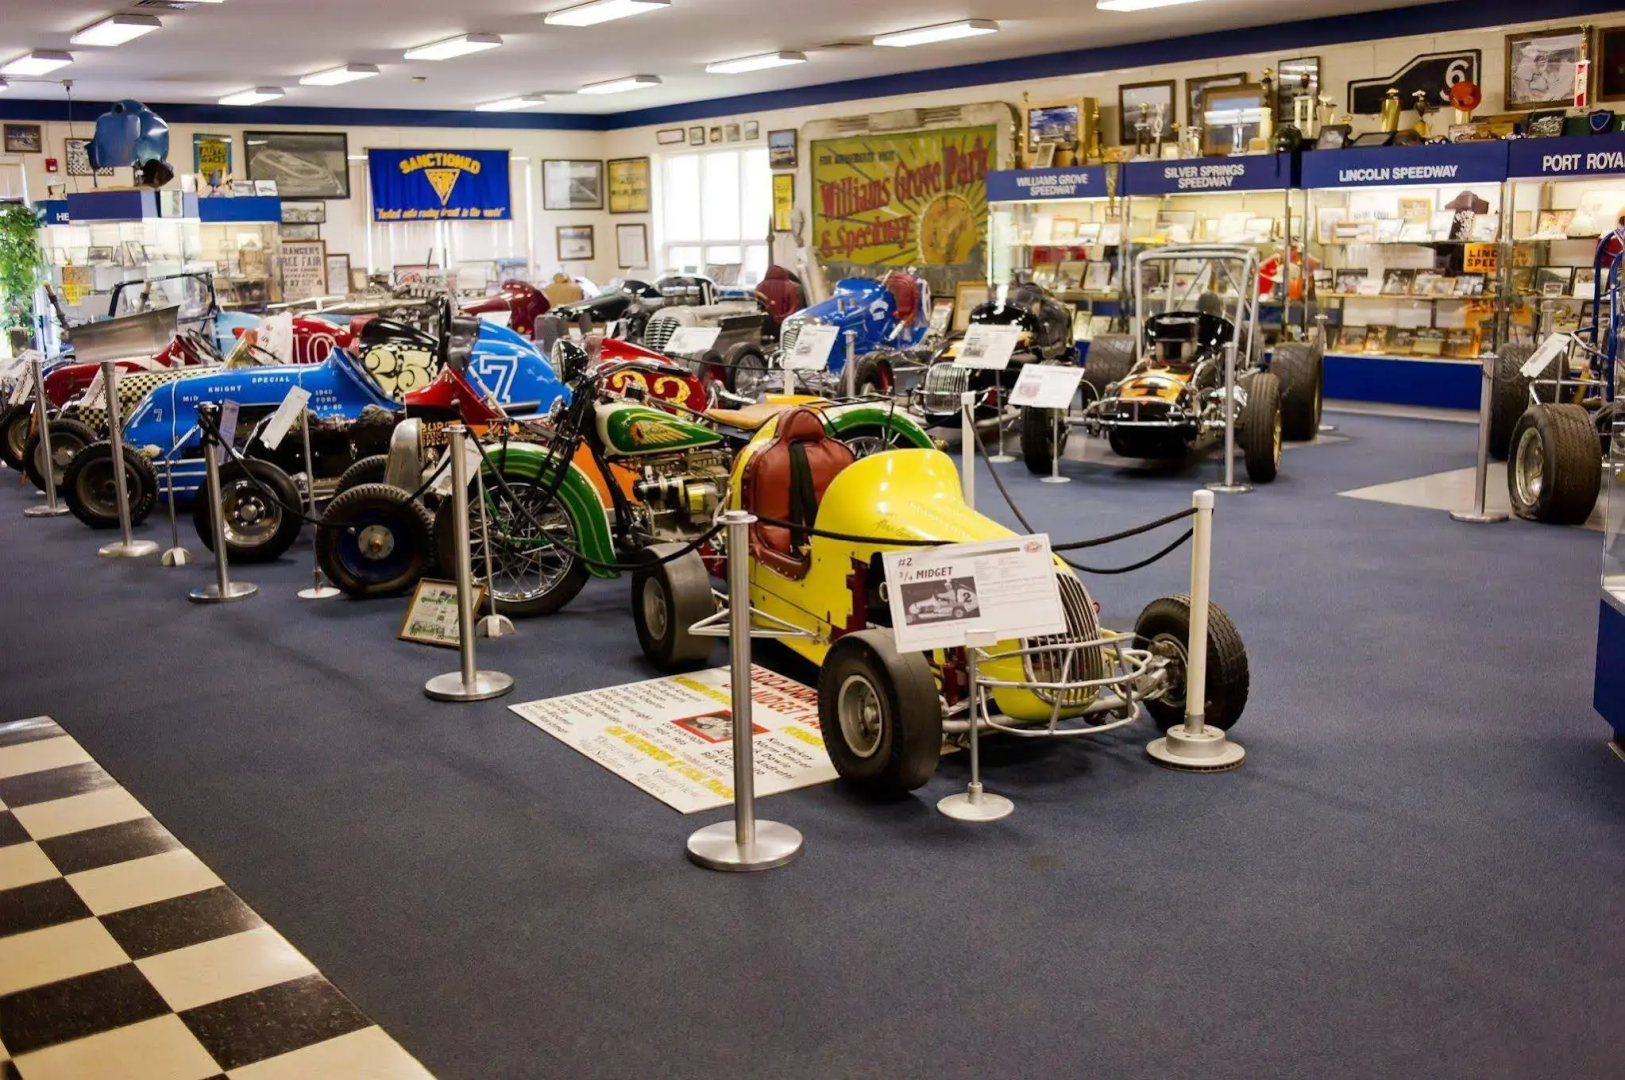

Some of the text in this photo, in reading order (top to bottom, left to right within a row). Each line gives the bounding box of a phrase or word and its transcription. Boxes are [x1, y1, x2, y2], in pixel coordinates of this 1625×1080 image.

[399, 152, 481, 175] SANCTIONED
[1542, 154, 1581, 171] PORT
[1164, 163, 1245, 178] SILVER SPRINGS
[1339, 165, 1458, 182] LINCOLN SPEEDWAY
[820, 177, 890, 222] Williams
[895, 160, 941, 202] Grove
[942, 137, 989, 190] Park
[1016, 173, 1088, 187] WILLIAMS GROVE
[1178, 175, 1233, 188] SPEEDWAY
[1030, 184, 1076, 196] SPEEDWAY
[837, 216, 911, 257] Speedway
[365, 350, 431, 393] 25
[479, 355, 518, 404] 7
[208, 385, 242, 393] KNIGHT
[153, 408, 163, 423] 7
[898, 557, 912, 567] #2
[916, 566, 953, 579] MIDGET
[963, 592, 972, 603] 2
[751, 689, 811, 716] MIDGET
